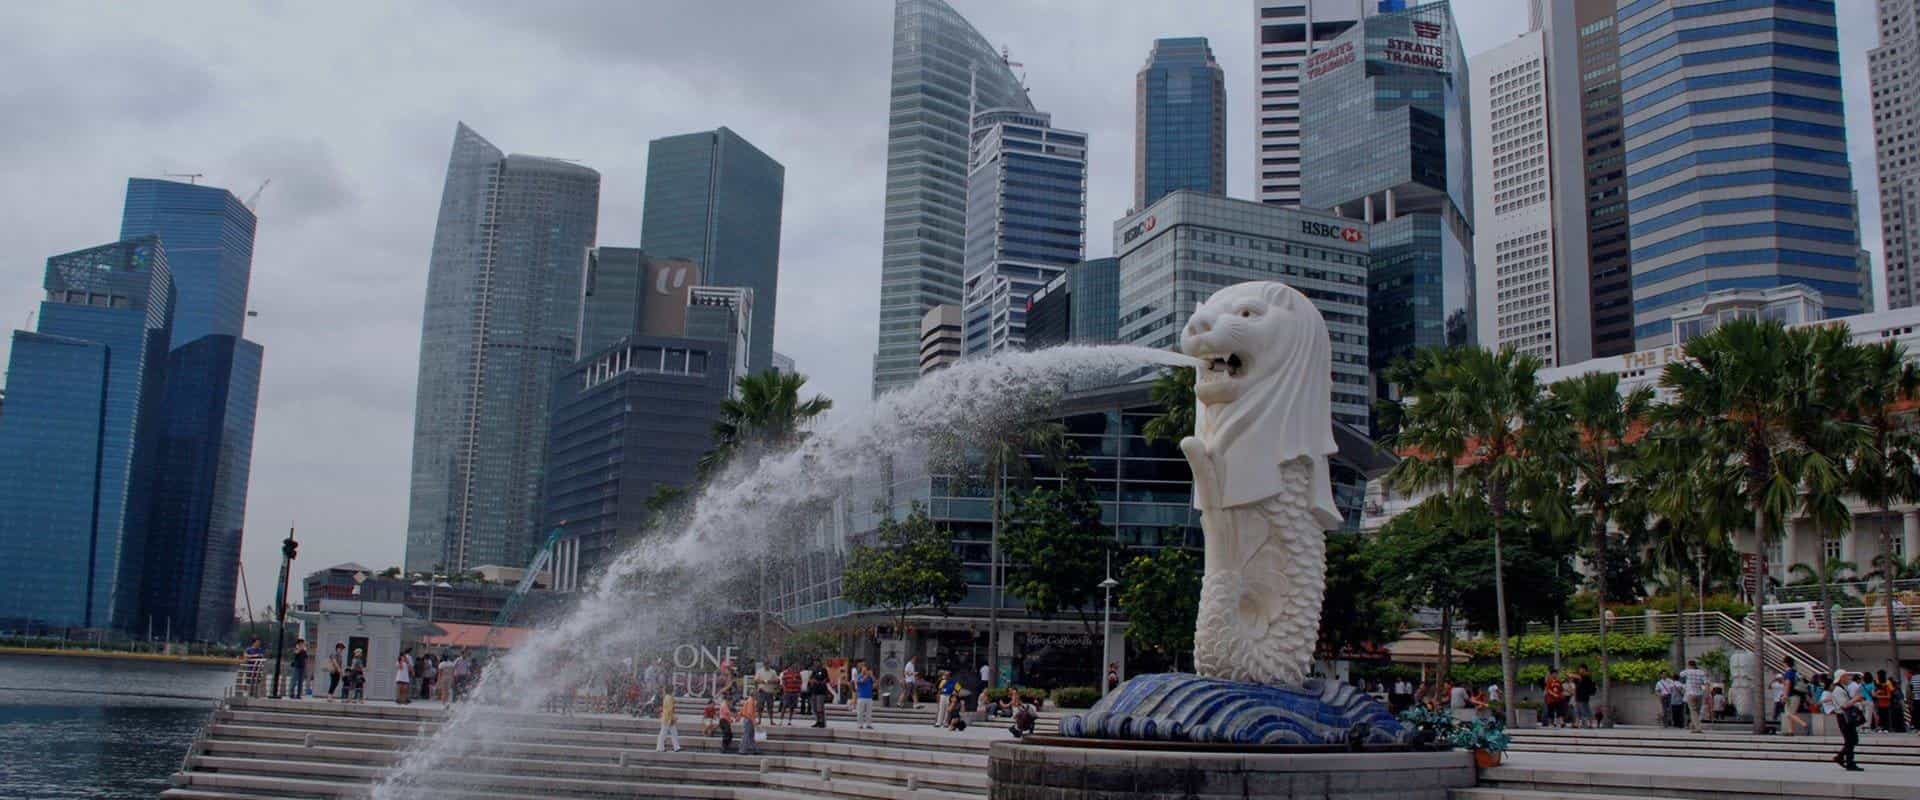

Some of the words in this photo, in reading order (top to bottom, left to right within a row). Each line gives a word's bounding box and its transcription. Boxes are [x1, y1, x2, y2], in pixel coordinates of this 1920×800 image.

[1306, 41, 1353, 67] STRAITS
[1387, 38, 1443, 56] STRAITS
[1306, 52, 1355, 79] TRADING
[1384, 51, 1443, 69] TRADING
[1302, 220, 1341, 239] HSBC
[1623, 351, 1656, 369] THE
[674, 644, 739, 670] ONE
